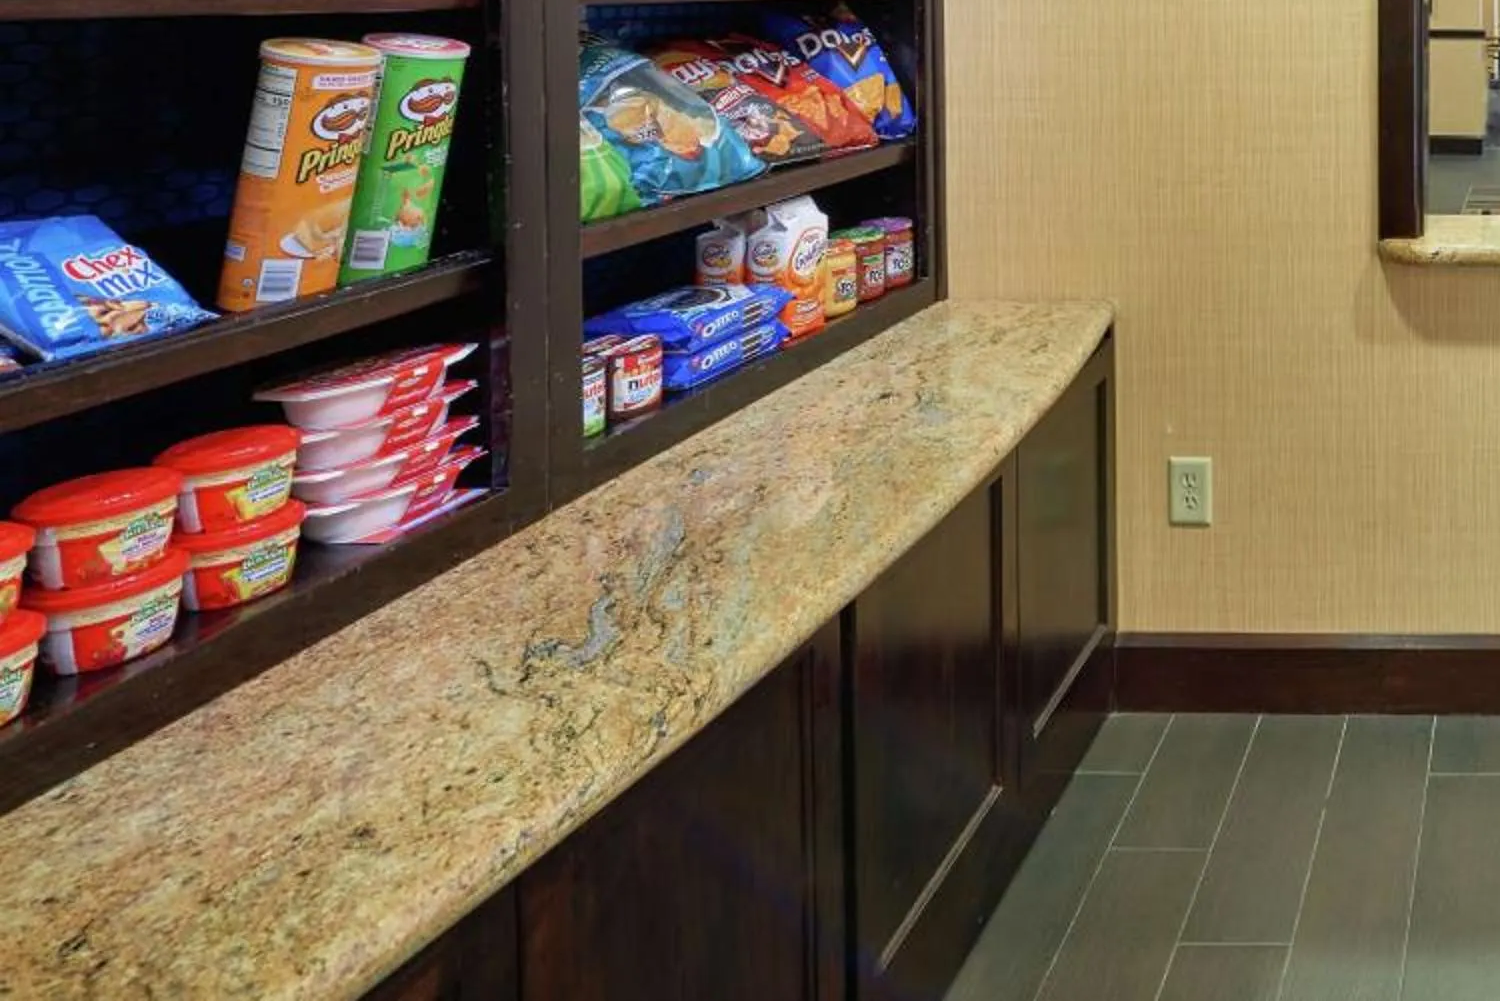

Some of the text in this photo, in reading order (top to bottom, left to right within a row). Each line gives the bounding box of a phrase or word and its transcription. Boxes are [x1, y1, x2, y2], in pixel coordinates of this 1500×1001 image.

[63, 246, 142, 280] Chex
[702, 307, 740, 338] OREO
[701, 339, 738, 370] OREO
